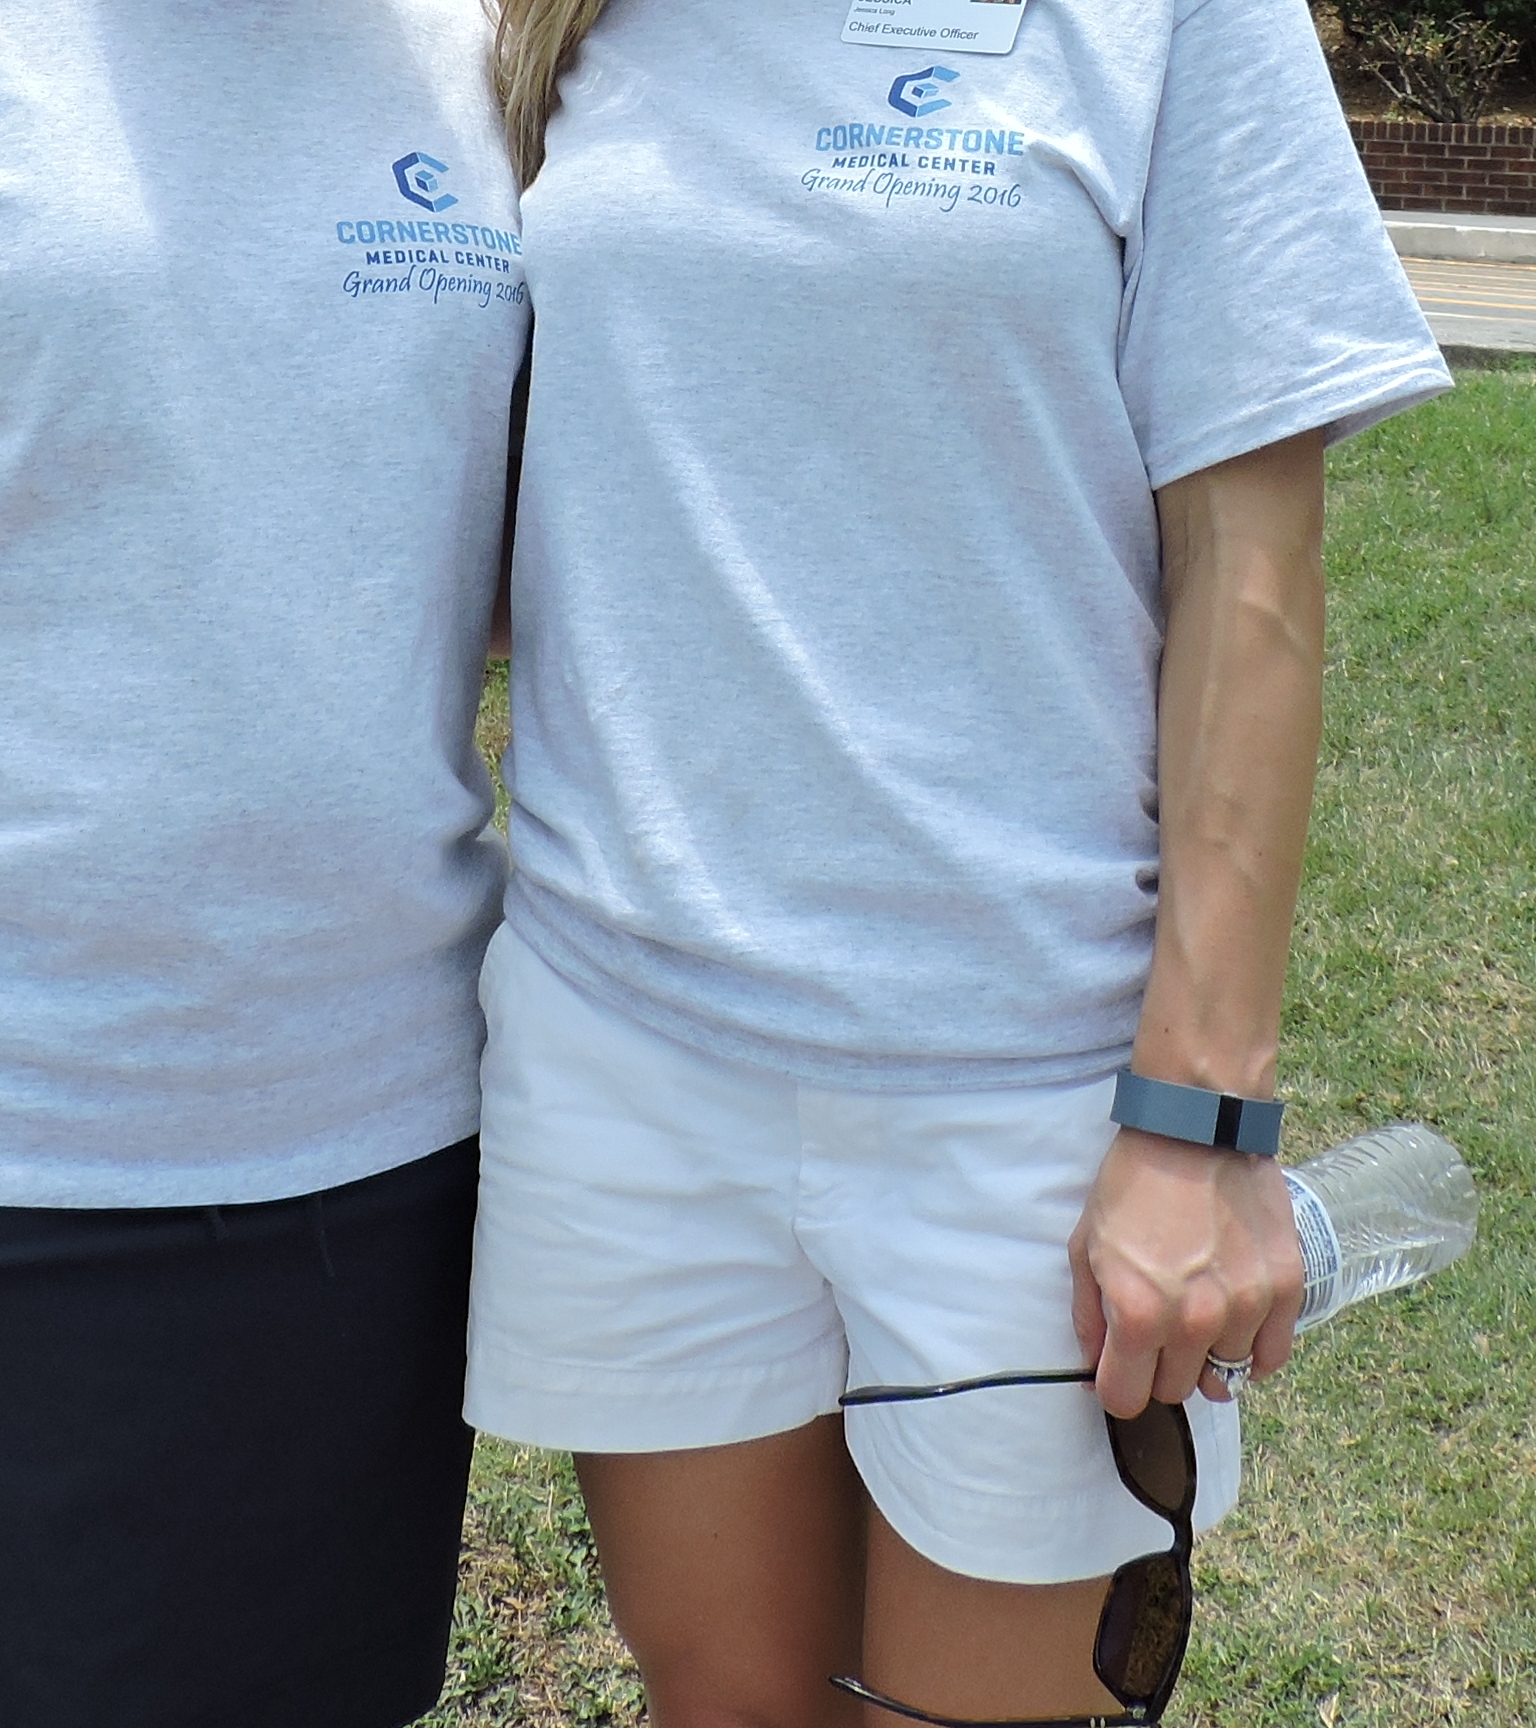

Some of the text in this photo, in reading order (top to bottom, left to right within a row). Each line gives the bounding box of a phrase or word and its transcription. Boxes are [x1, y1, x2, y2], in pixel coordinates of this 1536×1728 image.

[849, 21, 979, 40] Chief Executive Officer
[815, 123, 1025, 156] CORNERSTONE
[832, 153, 996, 176] MEDICAL CENTER
[801, 168, 1022, 212] Grand Opening 2016
[336, 220, 523, 256] CORNERSTONE
[366, 249, 510, 273] MEDICAL CENTER
[343, 265, 525, 308] Grand Opening 2016
